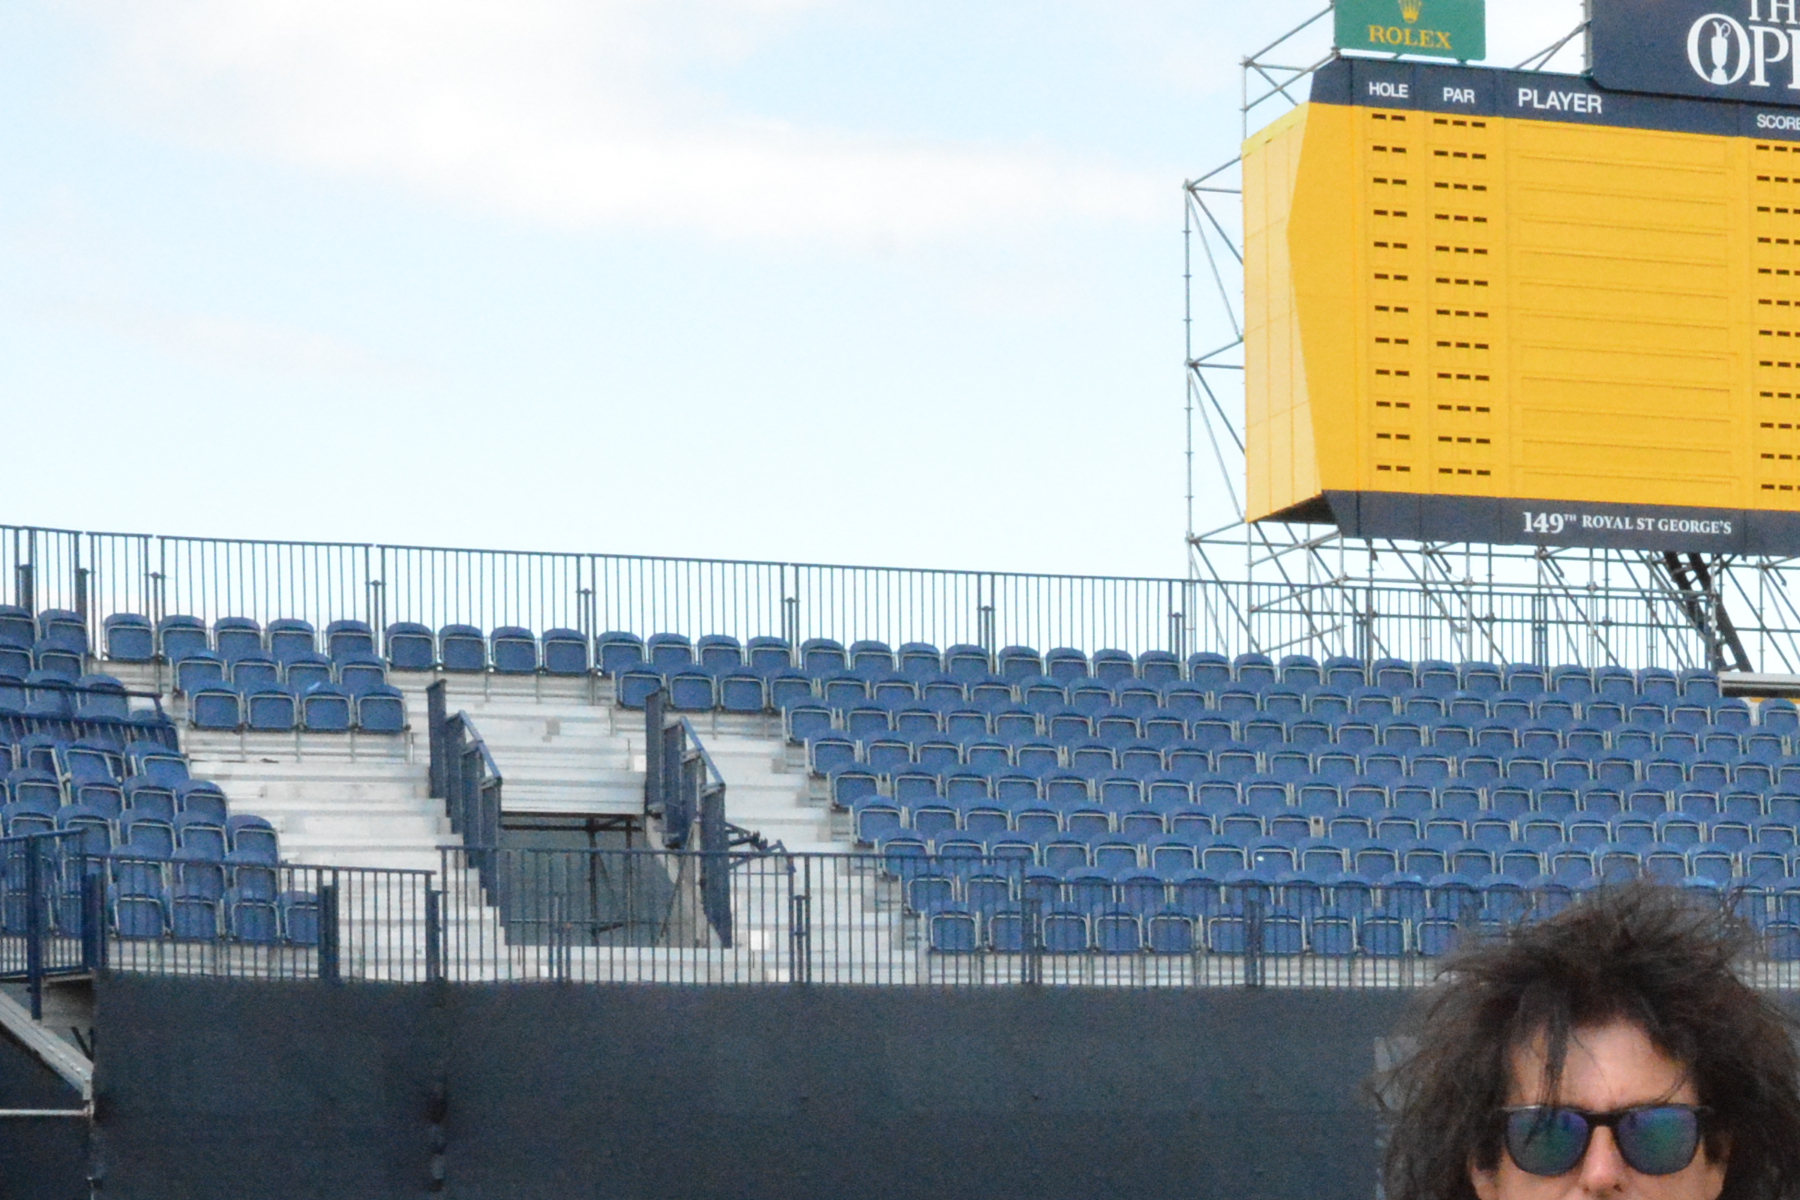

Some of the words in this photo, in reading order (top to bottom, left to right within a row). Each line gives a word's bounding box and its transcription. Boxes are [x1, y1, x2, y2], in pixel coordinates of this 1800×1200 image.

[1368, 25, 1452, 49] ROLEX
[1368, 82, 1409, 99] HOLE
[1443, 87, 1475, 104] PAR
[1518, 88, 1602, 114] PLAYER
[1582, 515, 1634, 531] ROYAL
[1636, 517, 1655, 531] ST
[1657, 519, 1732, 535] GEORGE'S
